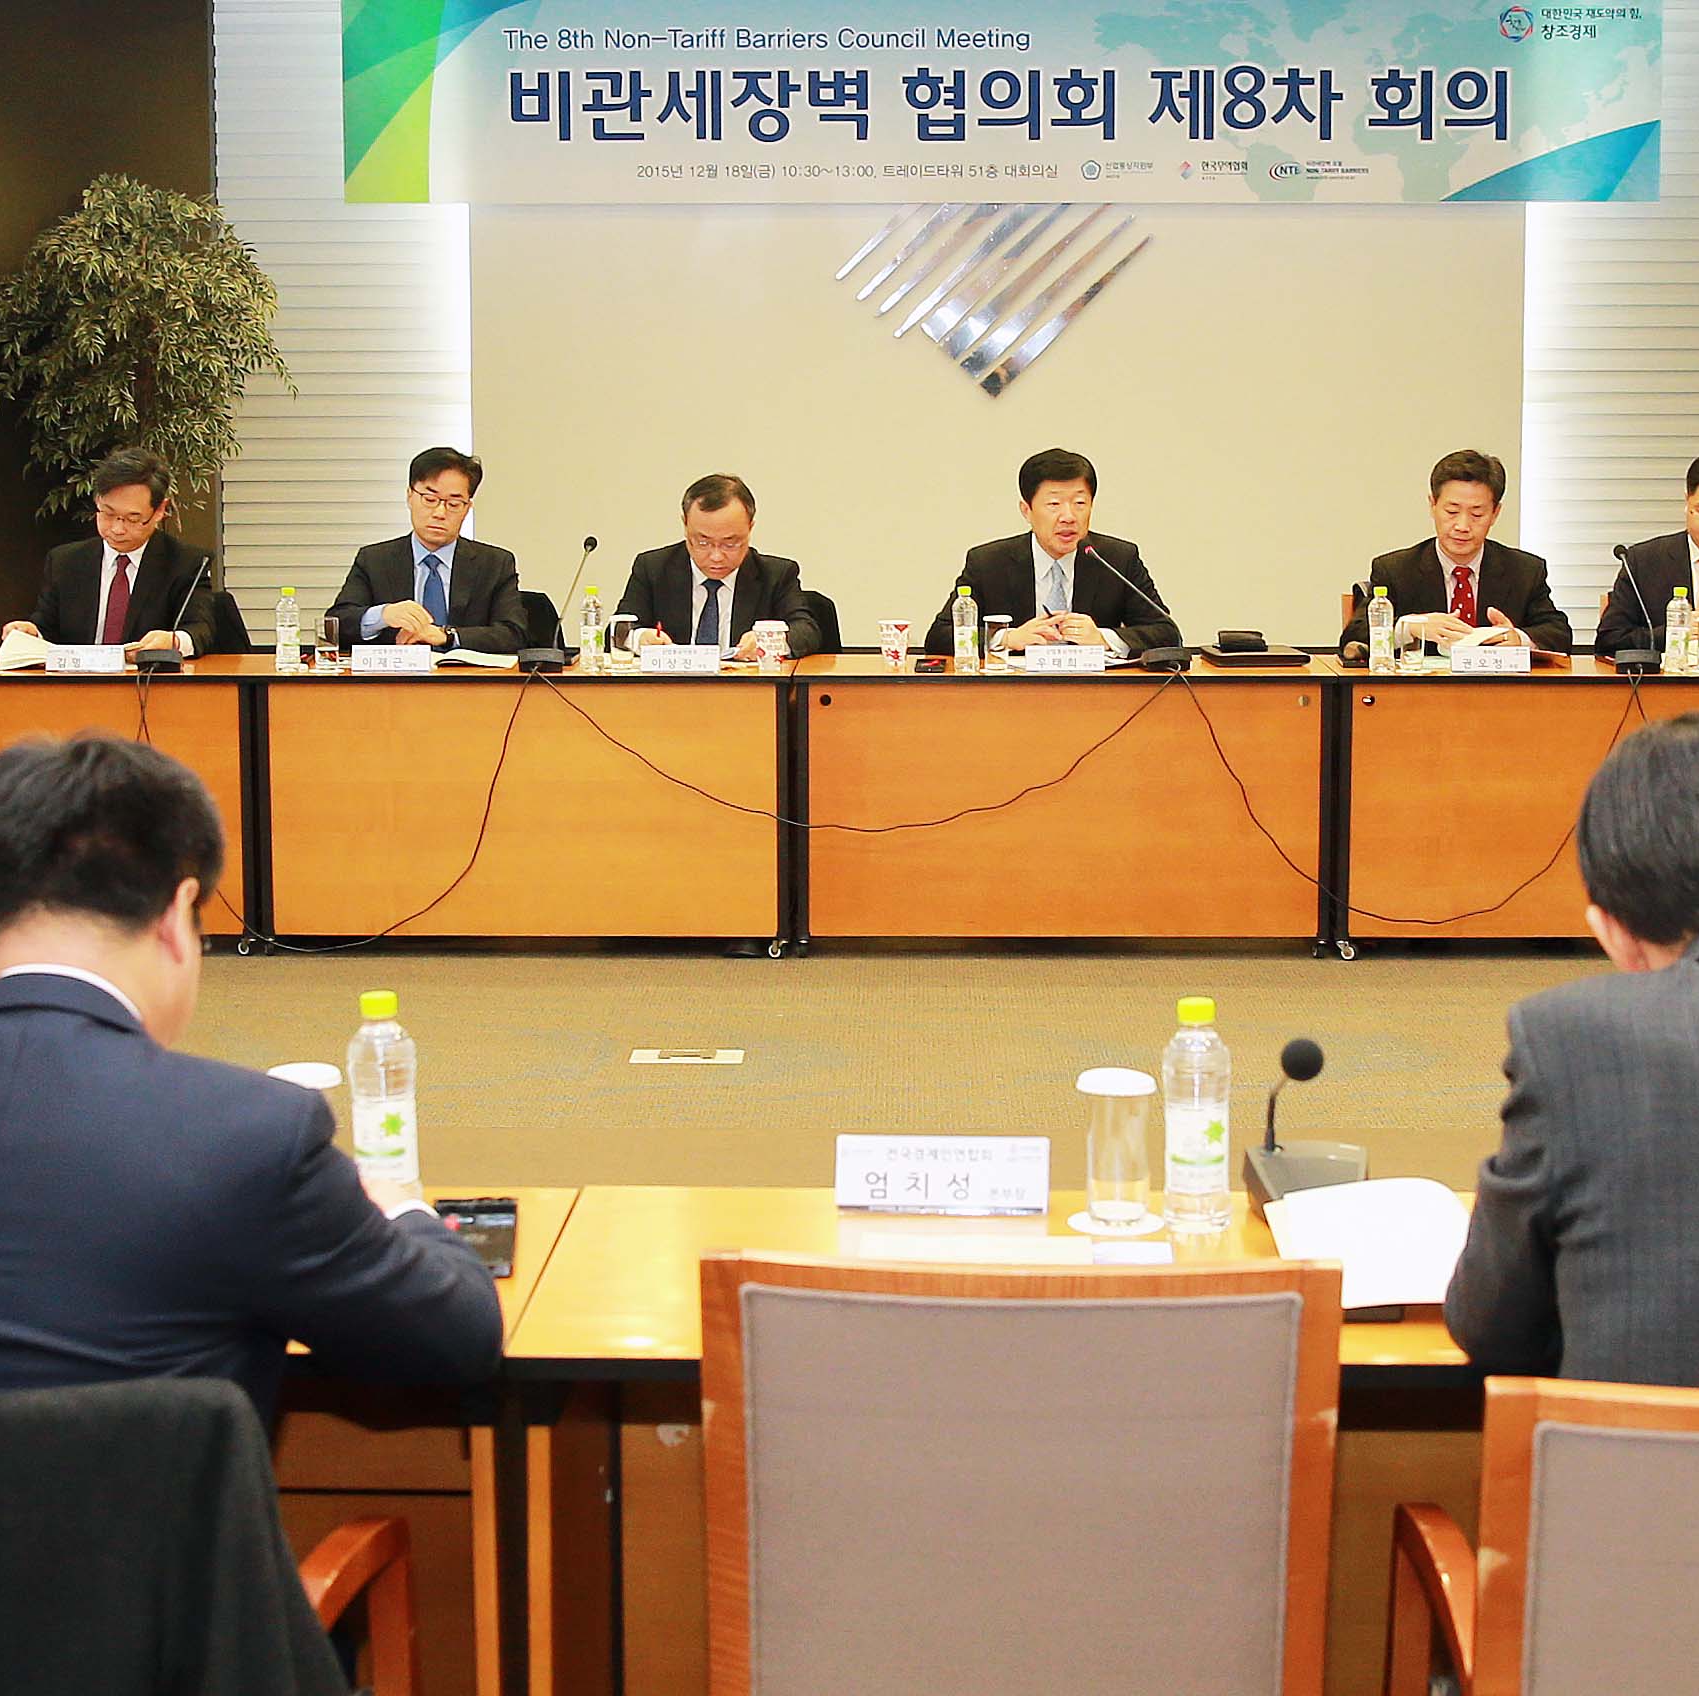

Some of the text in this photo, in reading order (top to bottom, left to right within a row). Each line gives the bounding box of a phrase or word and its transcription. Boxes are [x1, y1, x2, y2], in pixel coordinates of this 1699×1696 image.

[1541, 8, 1582, 20] 대한민국
[1586, 8, 1626, 20] 재도약의
[1541, 24, 1597, 40] 창조경제
[503, 27, 1030, 53] The 8th Non-Tariff Barriers Council Meeting
[510, 65, 1508, 142] 비관세장벽 협의회 제8차 회의
[637, 165, 682, 179] 2015년
[690, 164, 718, 178] 12월
[726, 164, 775, 179] 18일(금)
[882, 164, 963, 178] 트레이드타워
[969, 165, 999, 178] 51층
[1004, 164, 1058, 178] 대회의실
[1201, 160, 1248, 171] 한국무역협회
